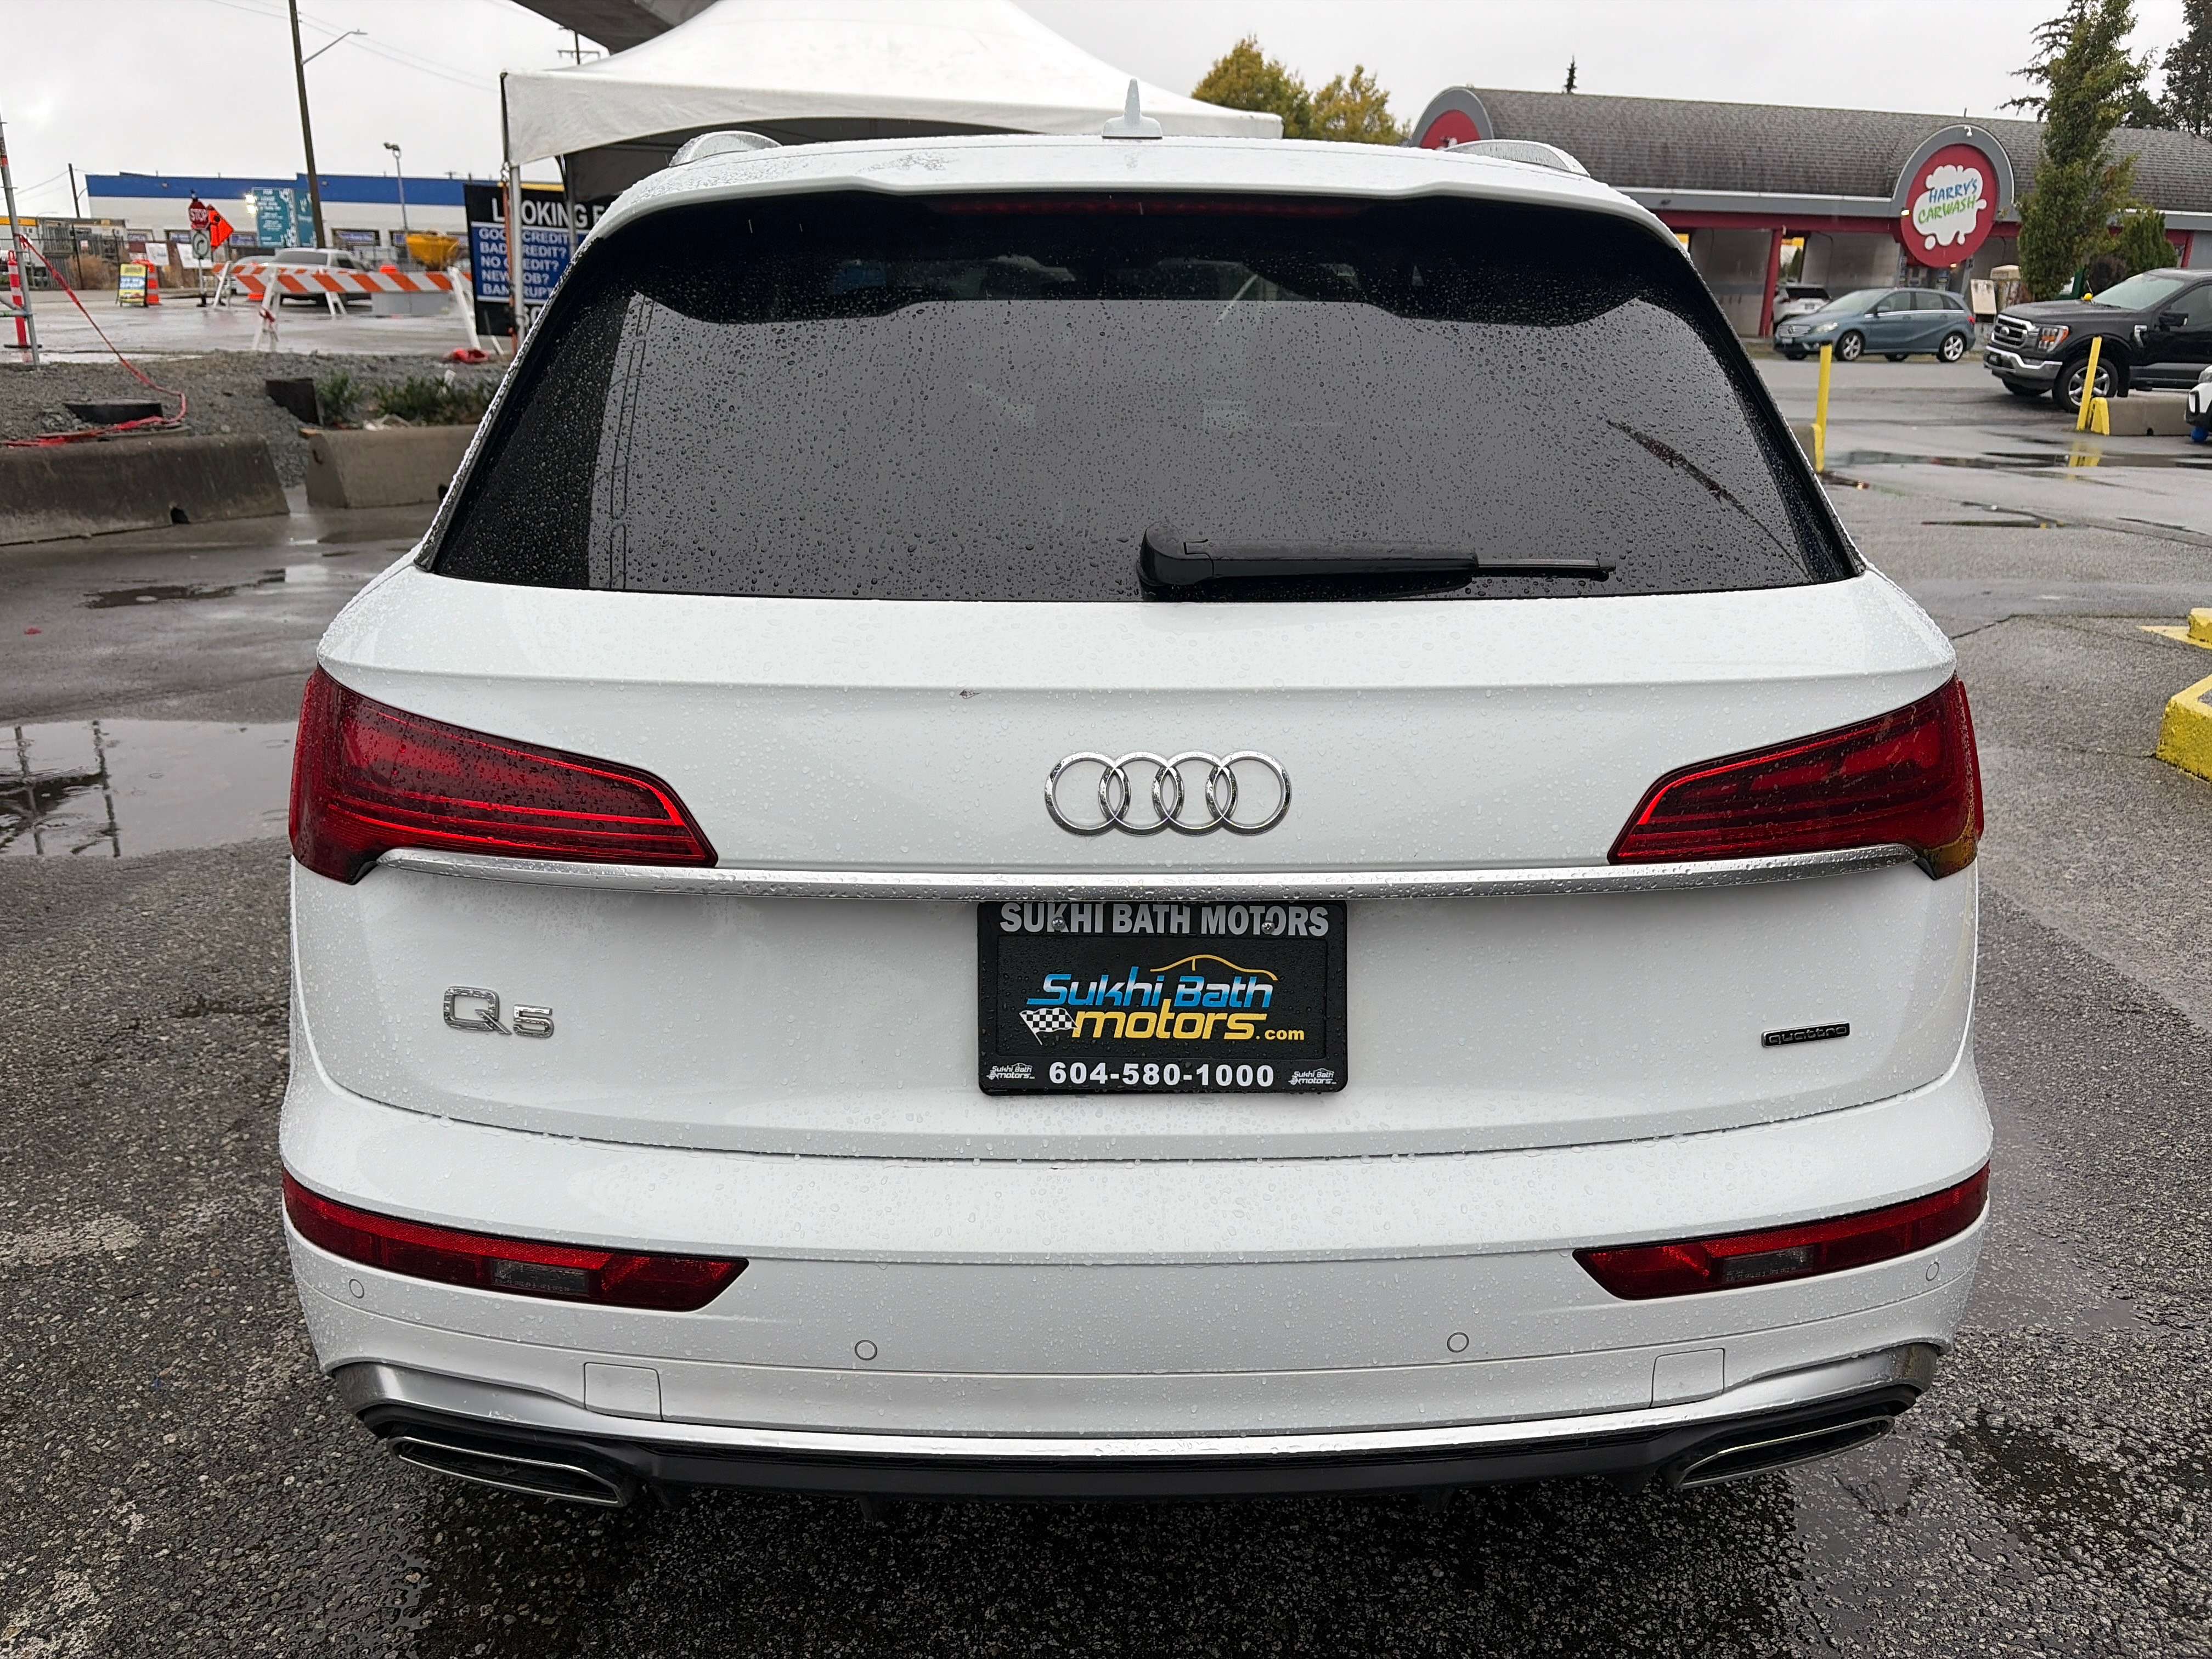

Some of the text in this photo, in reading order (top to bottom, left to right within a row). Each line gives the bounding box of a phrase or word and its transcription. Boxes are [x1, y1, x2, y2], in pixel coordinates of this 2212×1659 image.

[1929, 178, 1977, 203] HARRY'S
[190, 208, 207, 222] STOP
[492, 198, 588, 228] LOKING
[1918, 195, 1976, 224] CARWASH
[480, 241, 567, 259] BAD REDIT?
[481, 256, 500, 268] NO
[523, 272, 549, 285] OB?
[1000, 902, 1329, 936] SUKHI BATH MOTORS
[1026, 967, 1273, 1008] Sukhi Bath
[443, 986, 554, 1039] Q5
[1769, 1026, 1847, 1045] quattro
[1048, 1062, 1274, 1087] 604-580-1000
